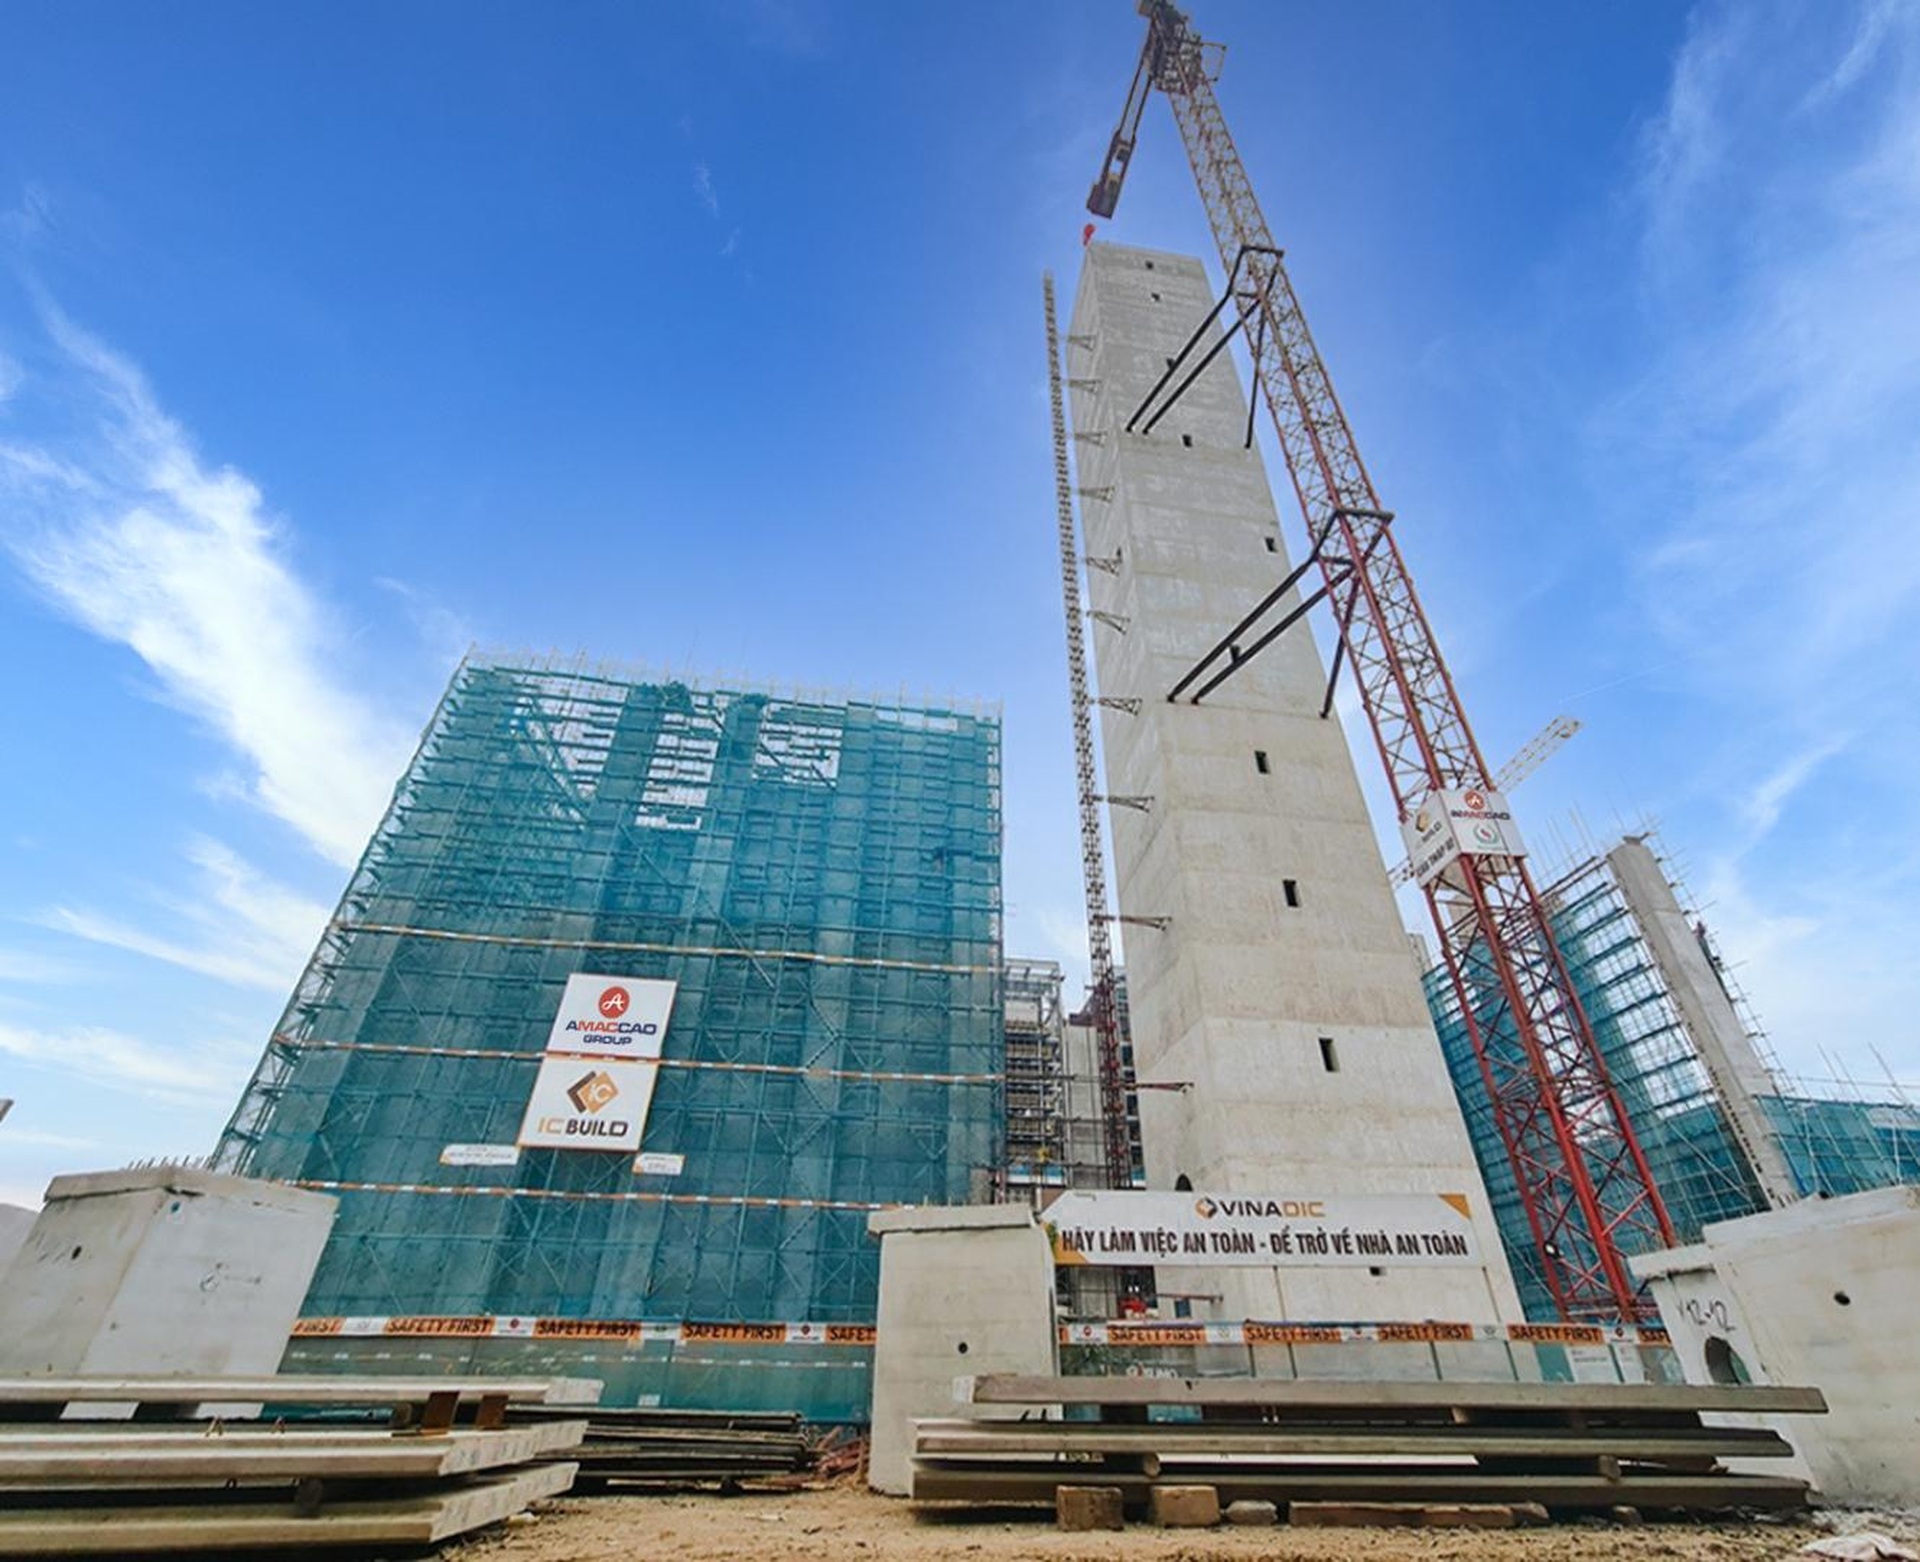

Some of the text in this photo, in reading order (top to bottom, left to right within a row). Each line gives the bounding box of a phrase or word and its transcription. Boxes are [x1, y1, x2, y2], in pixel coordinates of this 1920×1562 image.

[583, 1034, 632, 1045] GROUP
[1219, 1199, 1326, 1218] VINADIC
[1062, 1225, 1095, 1251] HÃY
[1100, 1226, 1136, 1253] LÀM
[1139, 1227, 1178, 1257] VIỆC
[1183, 1232, 1207, 1254] AN
[1212, 1228, 1256, 1254] TOÀN
[1396, 1234, 1421, 1255] AN
[1421, 1229, 1468, 1256] TOÀN
[387, 1318, 490, 1333] SAFETY FIRST
[536, 1318, 641, 1336] SAFETY FIRST
[683, 1324, 785, 1340] SAFETY FIRST
[1380, 1323, 1471, 1340] SAFETY FIRST
[1510, 1325, 1600, 1342] SAFETY FIRST
